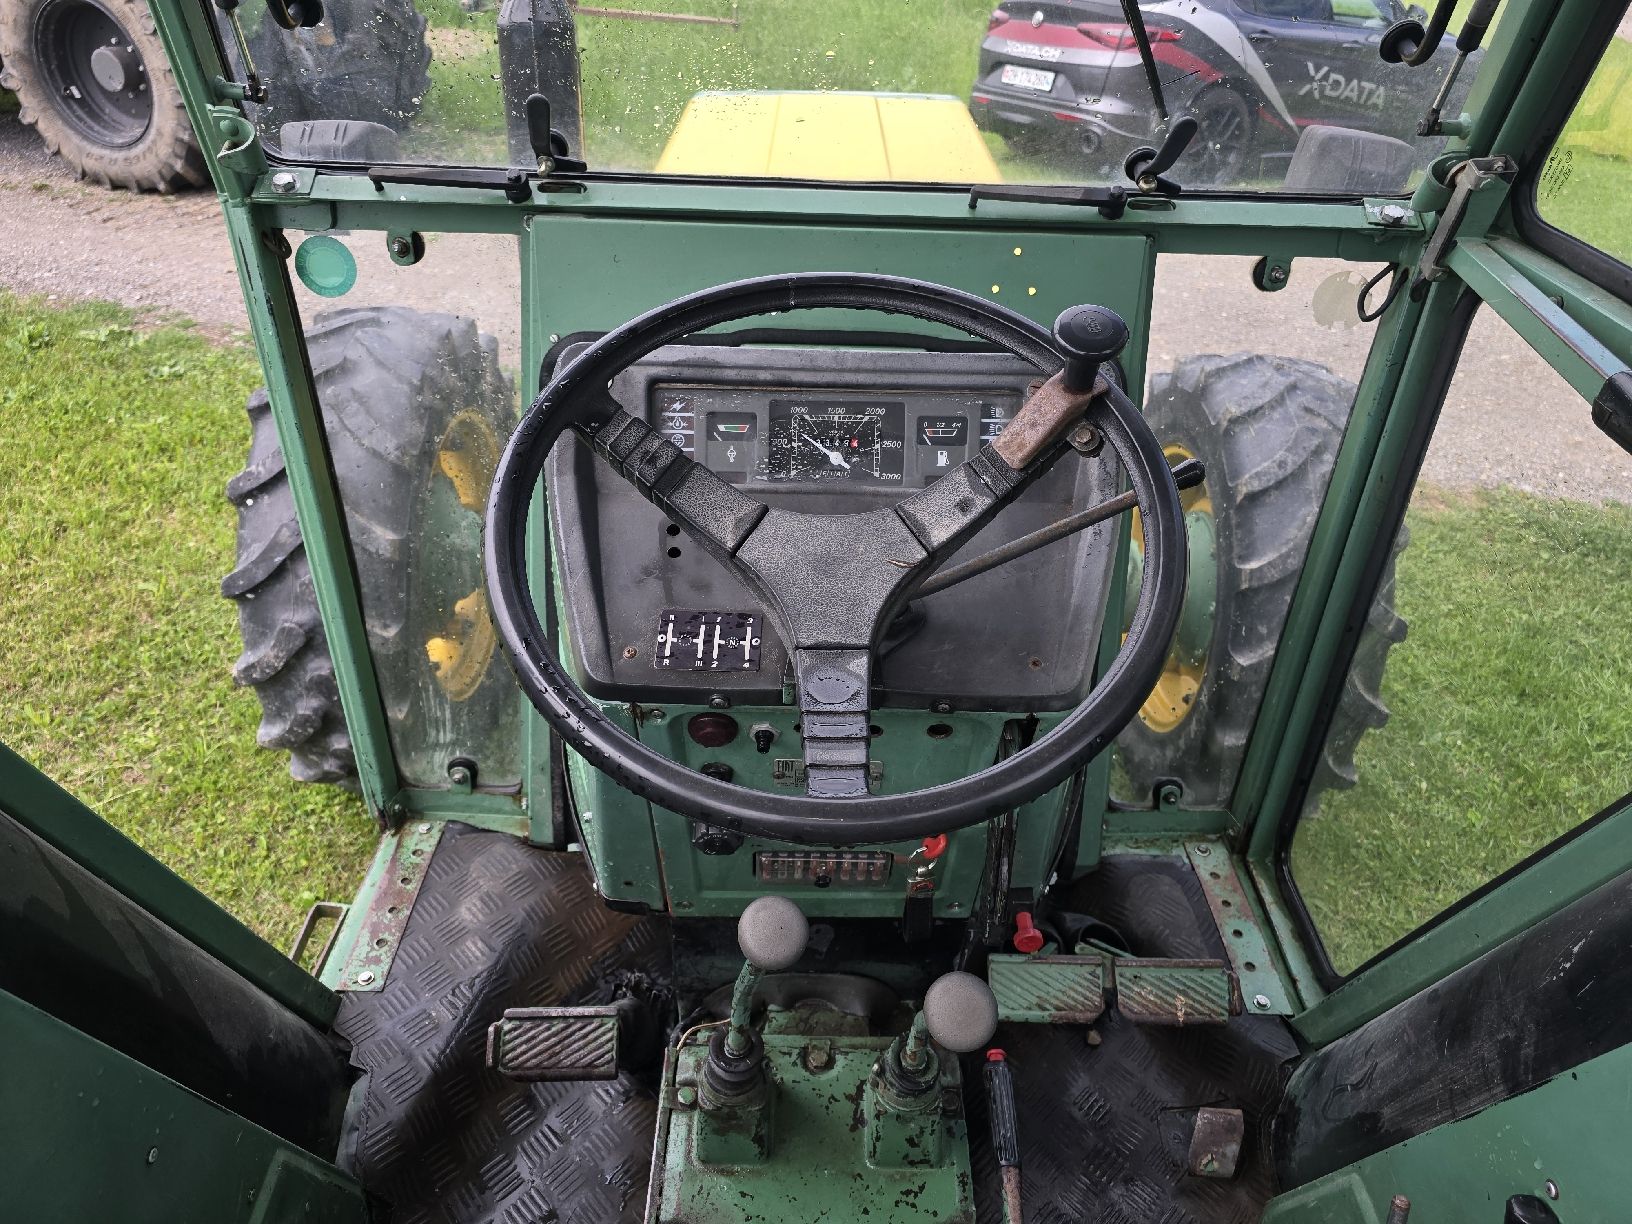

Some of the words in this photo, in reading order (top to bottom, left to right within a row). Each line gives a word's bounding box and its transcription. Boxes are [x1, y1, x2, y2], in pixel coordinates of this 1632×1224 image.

[790, 406, 809, 414] 1000
[827, 407, 846, 415] 1500
[865, 407, 886, 415] 2000
[881, 440, 902, 448] 2500
[880, 472, 902, 480] 3000
[710, 660, 719, 668] 2
